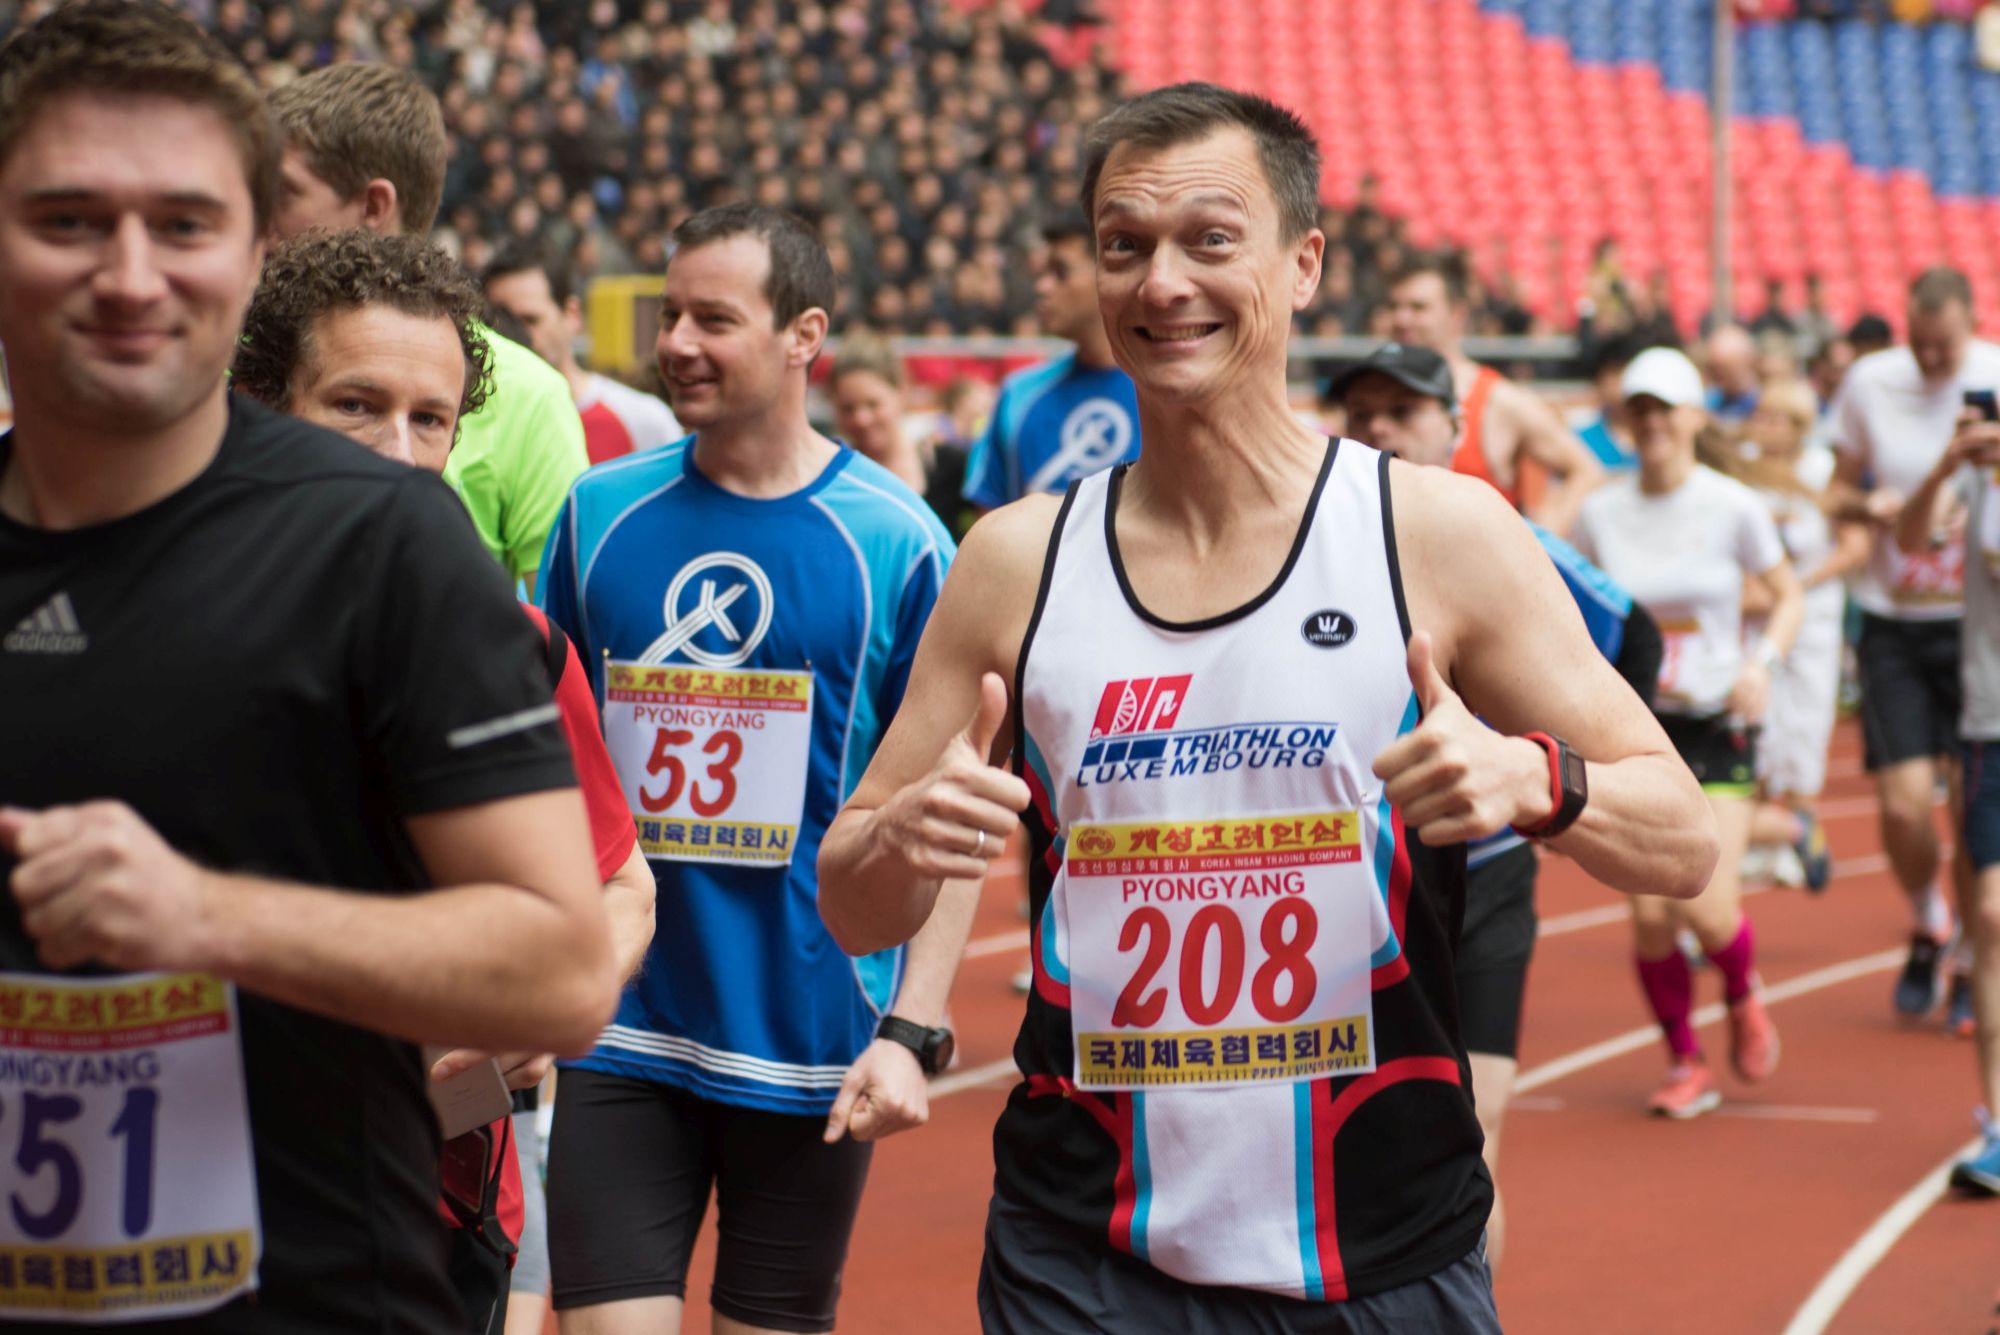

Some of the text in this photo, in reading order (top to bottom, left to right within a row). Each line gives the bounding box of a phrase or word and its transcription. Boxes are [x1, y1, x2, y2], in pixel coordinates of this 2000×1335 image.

[1309, 633, 1347, 642] vermarc
[634, 705, 765, 730] PYONGYANG
[1171, 728, 1337, 757] TRIATHLON
[639, 727, 743, 818] 53
[1077, 750, 1326, 788] LUXEMBOURG
[636, 821, 789, 850] 체육협력회사
[1128, 818, 1350, 854] 개성고려인삼
[1200, 849, 1353, 869] KOREA INSAM TRADING COMPANY
[1122, 871, 1305, 902] PYONGYANG
[1111, 896, 1318, 1028] 208
[1090, 1023, 1357, 1069] 국제체육협력회사
[0, 1084, 160, 1240] 51
